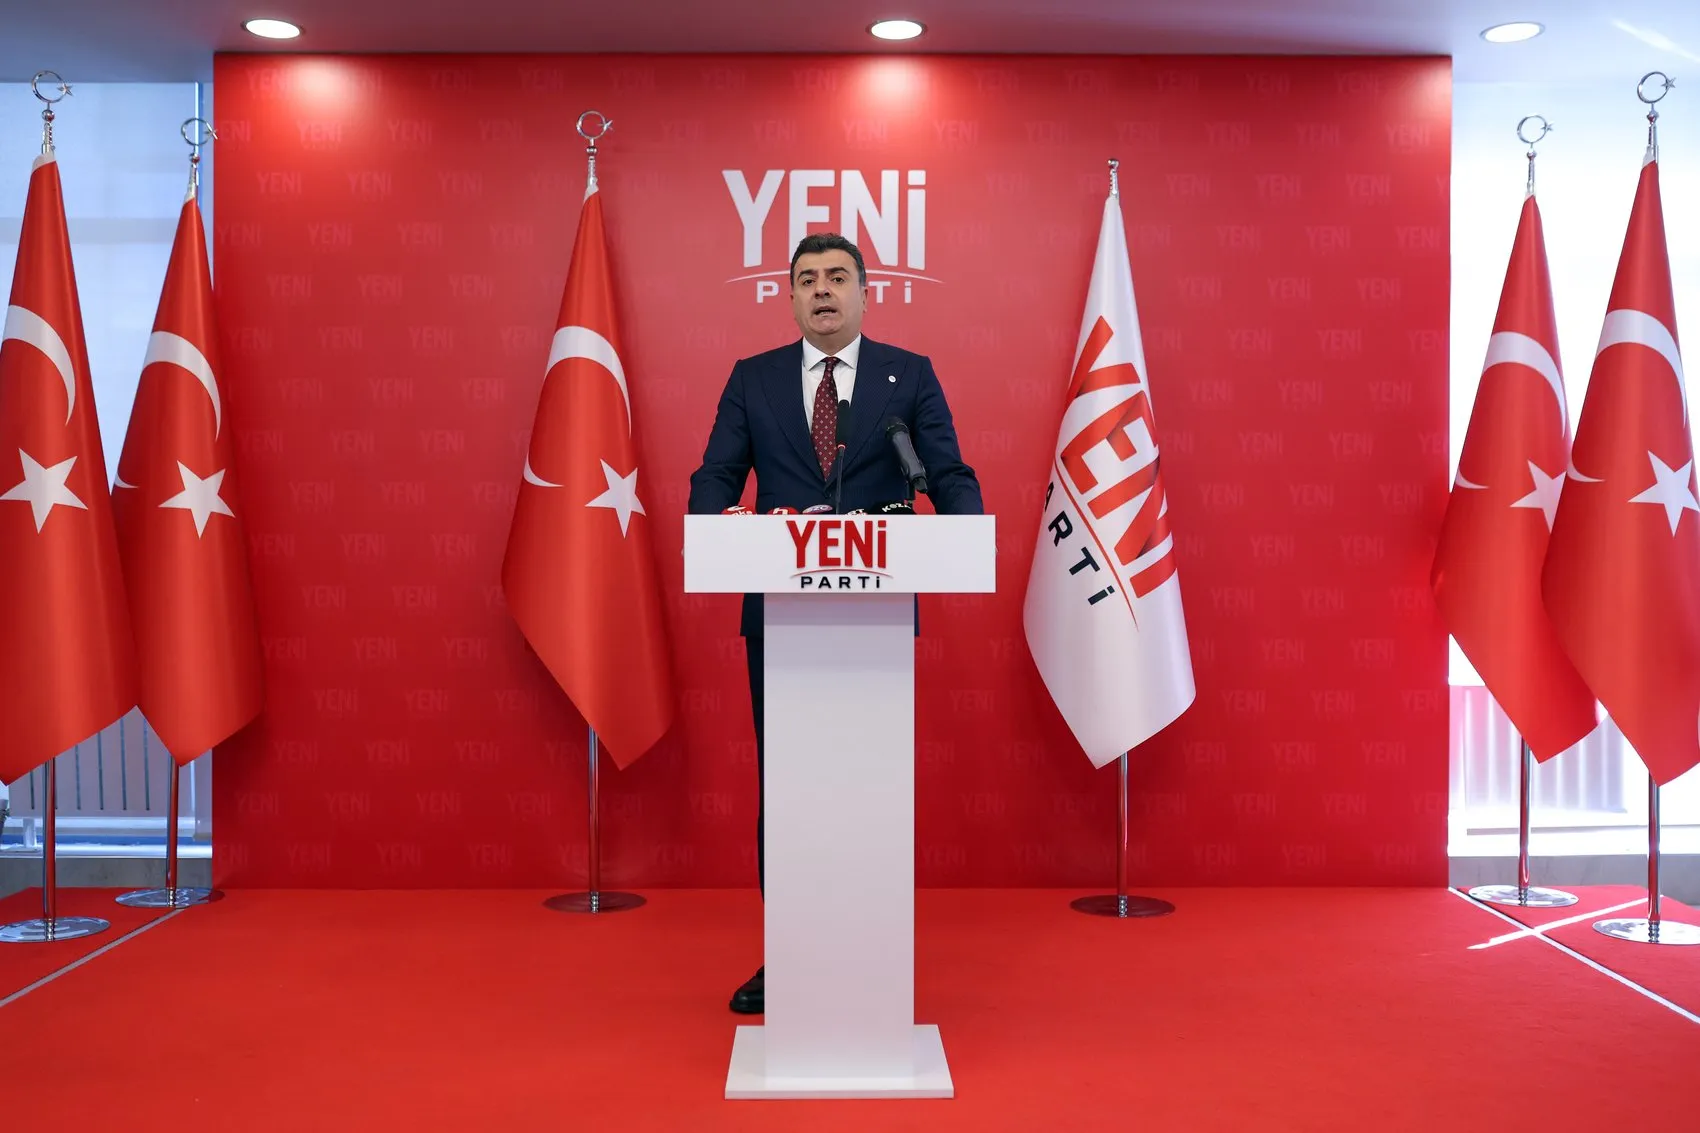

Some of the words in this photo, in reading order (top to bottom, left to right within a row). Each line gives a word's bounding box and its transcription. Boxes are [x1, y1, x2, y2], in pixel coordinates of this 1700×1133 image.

[757, 281, 912, 303] PTi
[786, 520, 887, 568] YENi
[801, 576, 881, 589] PARTi
